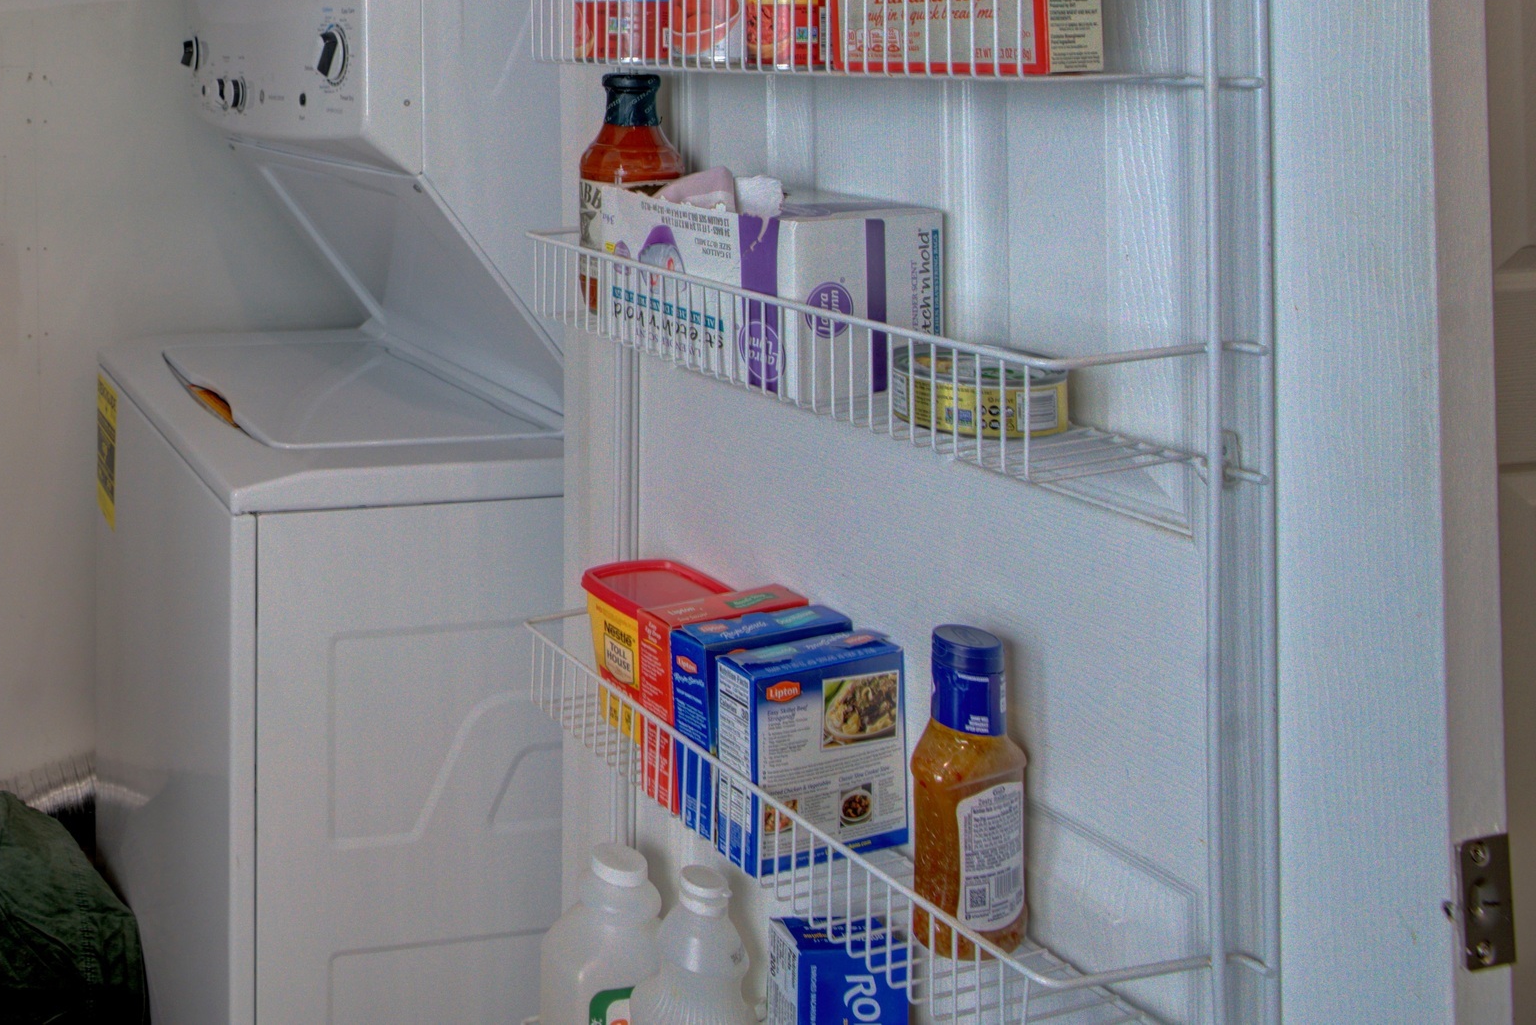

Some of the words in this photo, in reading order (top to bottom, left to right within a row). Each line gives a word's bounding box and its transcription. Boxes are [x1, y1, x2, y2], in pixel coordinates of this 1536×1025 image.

[702, 247, 725, 258] GALLON
[817, 292, 829, 331] Lara
[830, 289, 839, 316] ynn
[609, 641, 627, 660] TOLL
[606, 649, 631, 673] HOUSE
[677, 658, 697, 672] Lipton
[768, 686, 799, 699] Lipton
